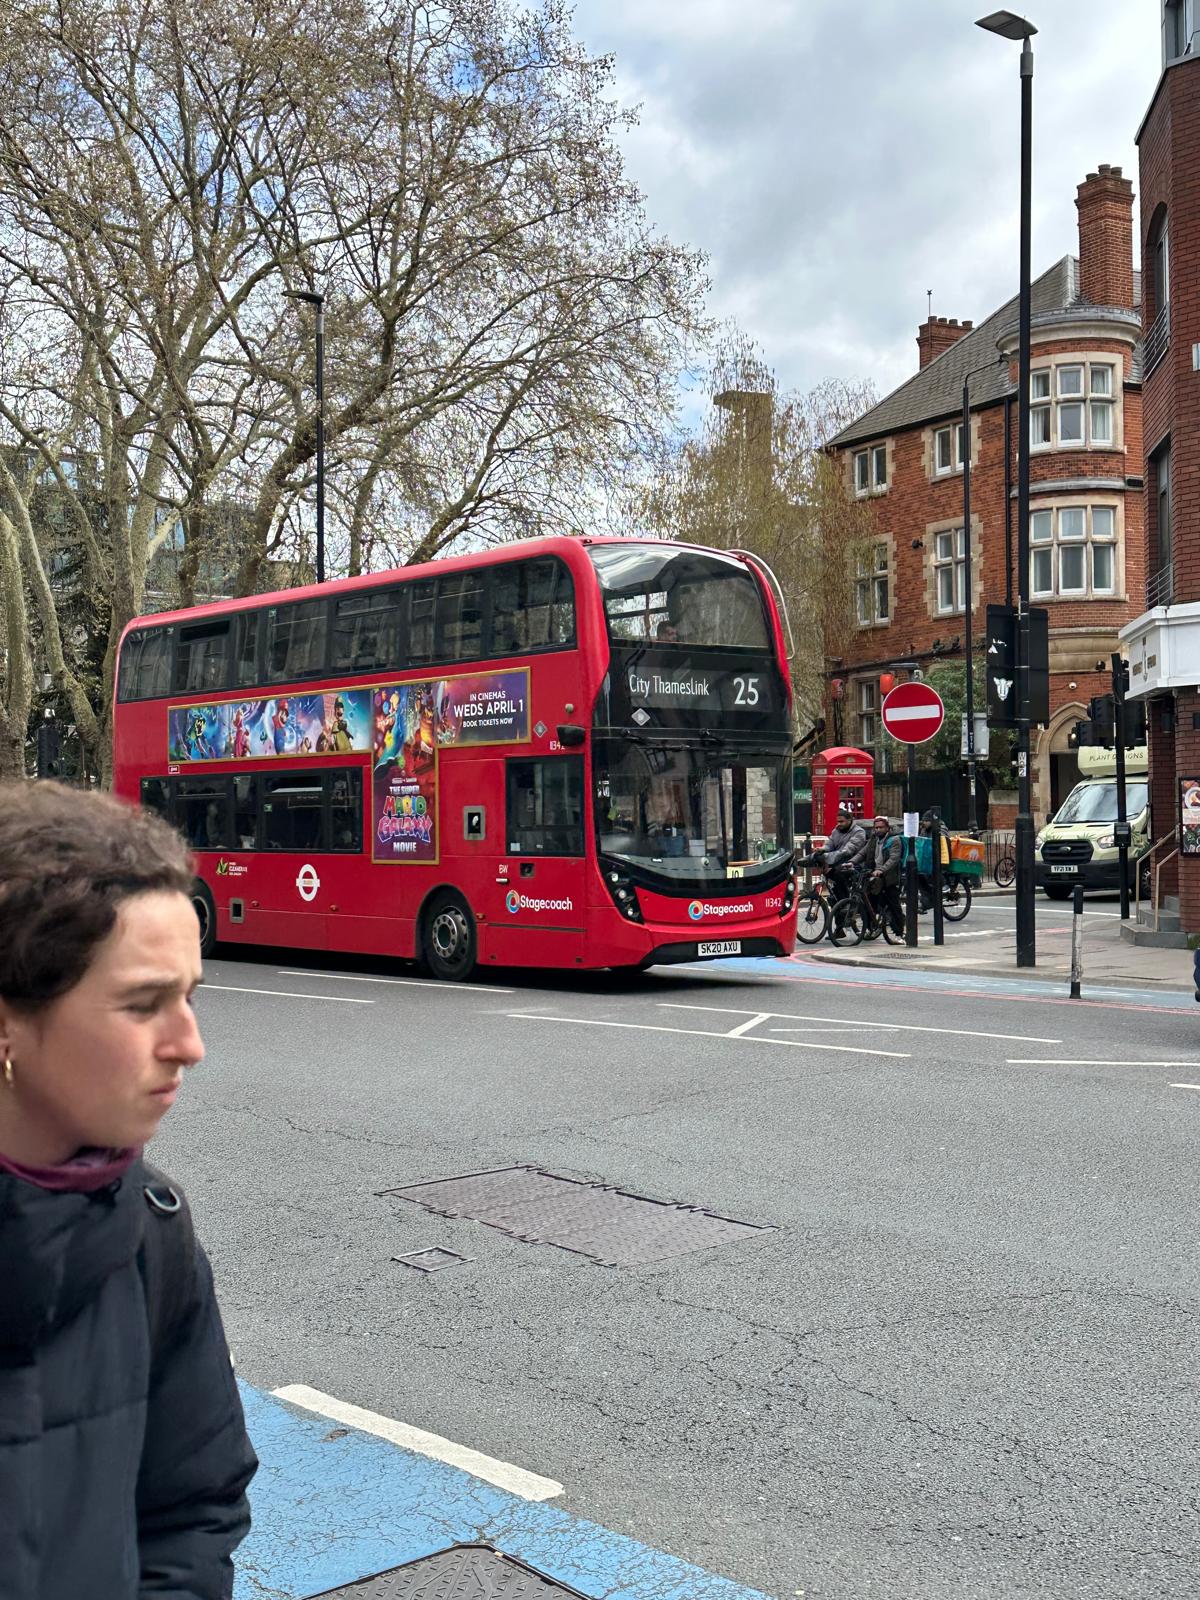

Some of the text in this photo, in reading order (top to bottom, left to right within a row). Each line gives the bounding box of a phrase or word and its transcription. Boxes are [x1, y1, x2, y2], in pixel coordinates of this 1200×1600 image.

[629, 674, 710, 698] City Thameslink
[733, 677, 759, 705] 25
[470, 690, 506, 701] IN CINEMAS
[453, 699, 523, 718] WEDS APRIL 1
[462, 717, 514, 728] BOOK TICKETS NOW
[1089, 752, 1144, 762] PLANT DIGNS
[383, 795, 427, 817] MARIO
[377, 815, 433, 843] GALAXY
[393, 842, 417, 853] MOVIE
[520, 895, 573, 912] Stagecoach
[703, 901, 754, 917] Stagecoach
[765, 898, 782, 908] 11342
[701, 942, 738, 954] SK20 AXU
